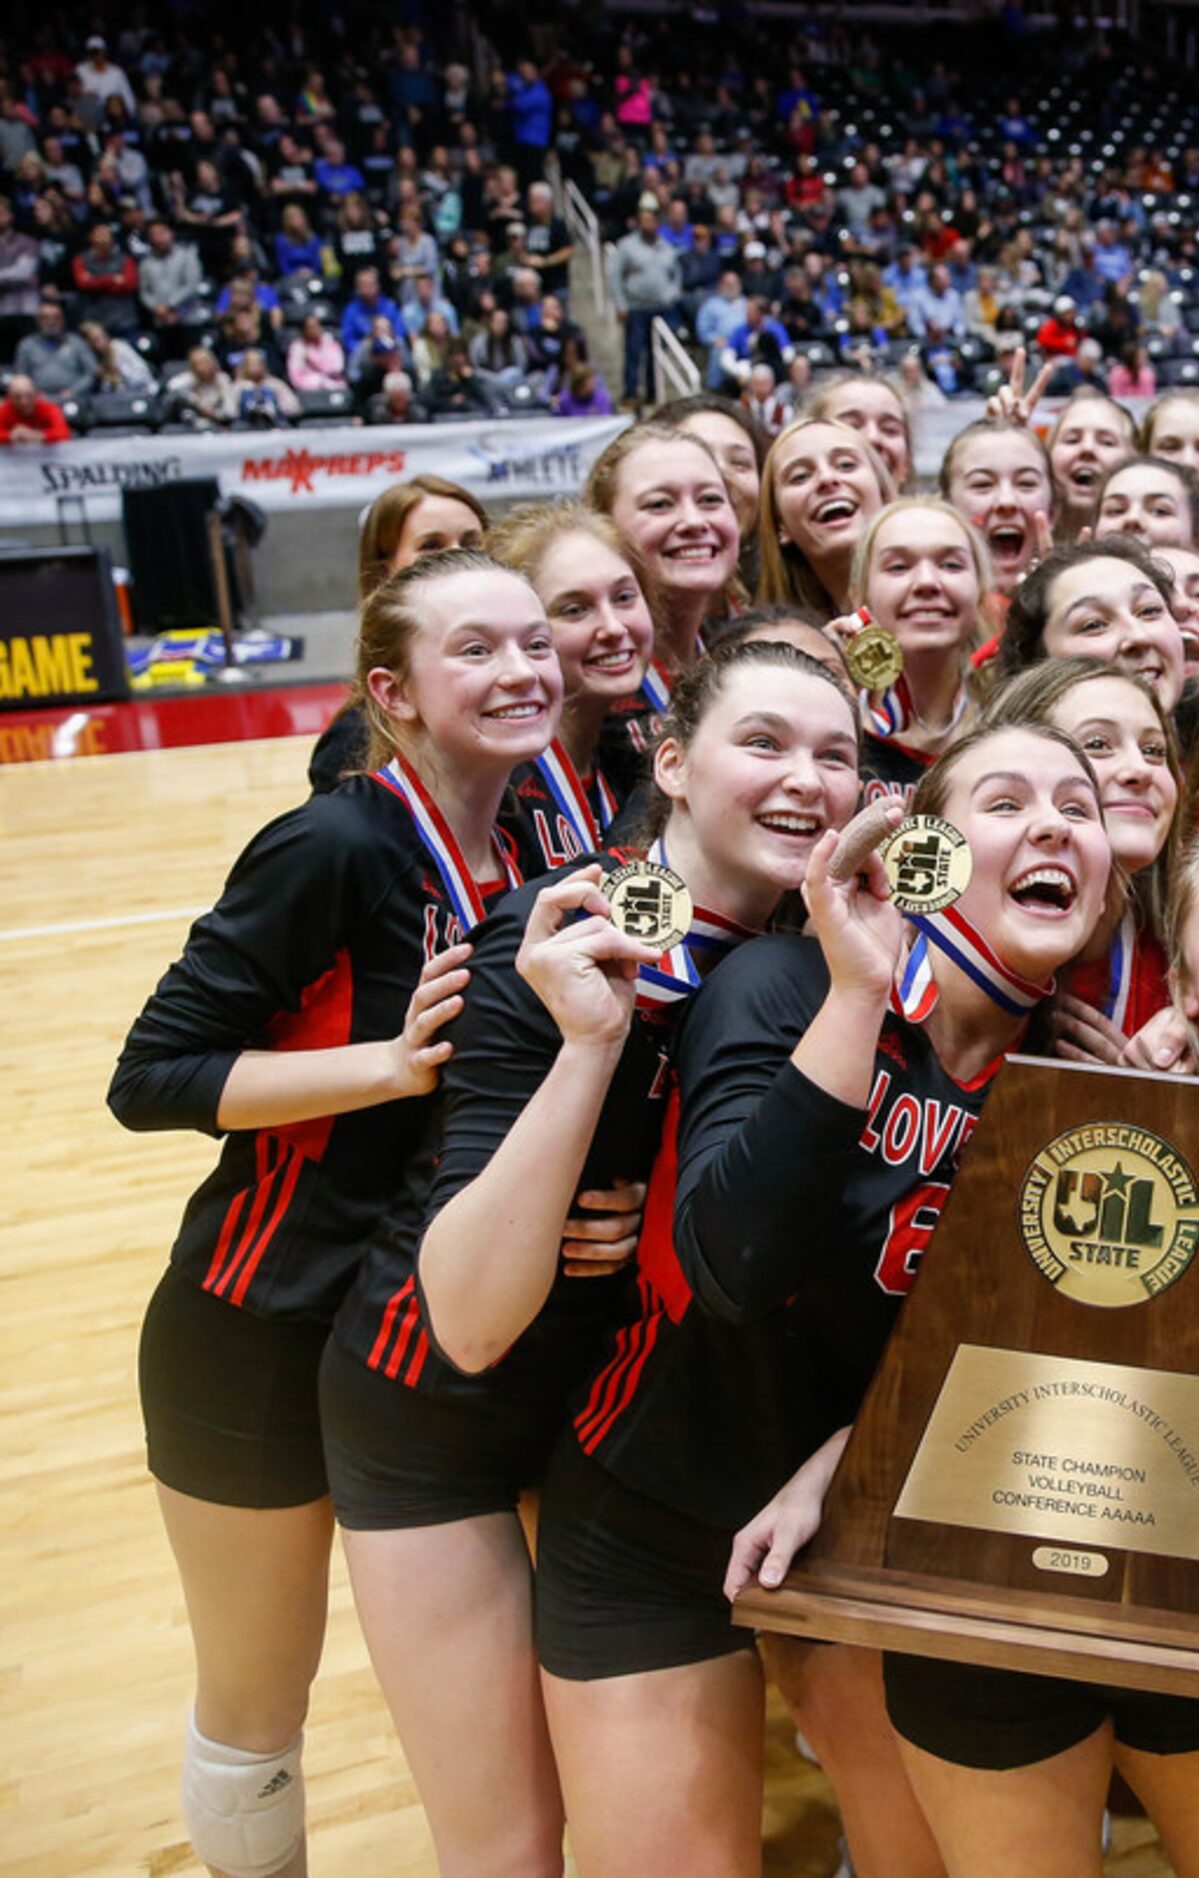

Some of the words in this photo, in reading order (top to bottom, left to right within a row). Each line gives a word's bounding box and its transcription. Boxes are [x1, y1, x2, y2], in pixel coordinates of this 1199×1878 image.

[40, 456, 180, 492] SPALDING
[1022, 1167, 1064, 1281] UNIVERSITY
[1051, 1128, 1196, 1206] INTERSCHOLASTIC
[1148, 1223, 1198, 1291] LEAGUE
[1054, 1163, 1165, 1249] UIL
[1069, 1241, 1140, 1268] STATE
[955, 1391, 1030, 1454] UNIVERSITY
[1034, 1381, 1165, 1432] INTERSCHOLASTIC
[1012, 1451, 1057, 1470] STATE
[1062, 1458, 1146, 1483] CHAMPION
[1028, 1475, 1125, 1501] VOLLEYBALL
[992, 1490, 1097, 1518] CONFERENCE
[1101, 1507, 1156, 1526] AAAAA
[1050, 1552, 1092, 1571] 2019
